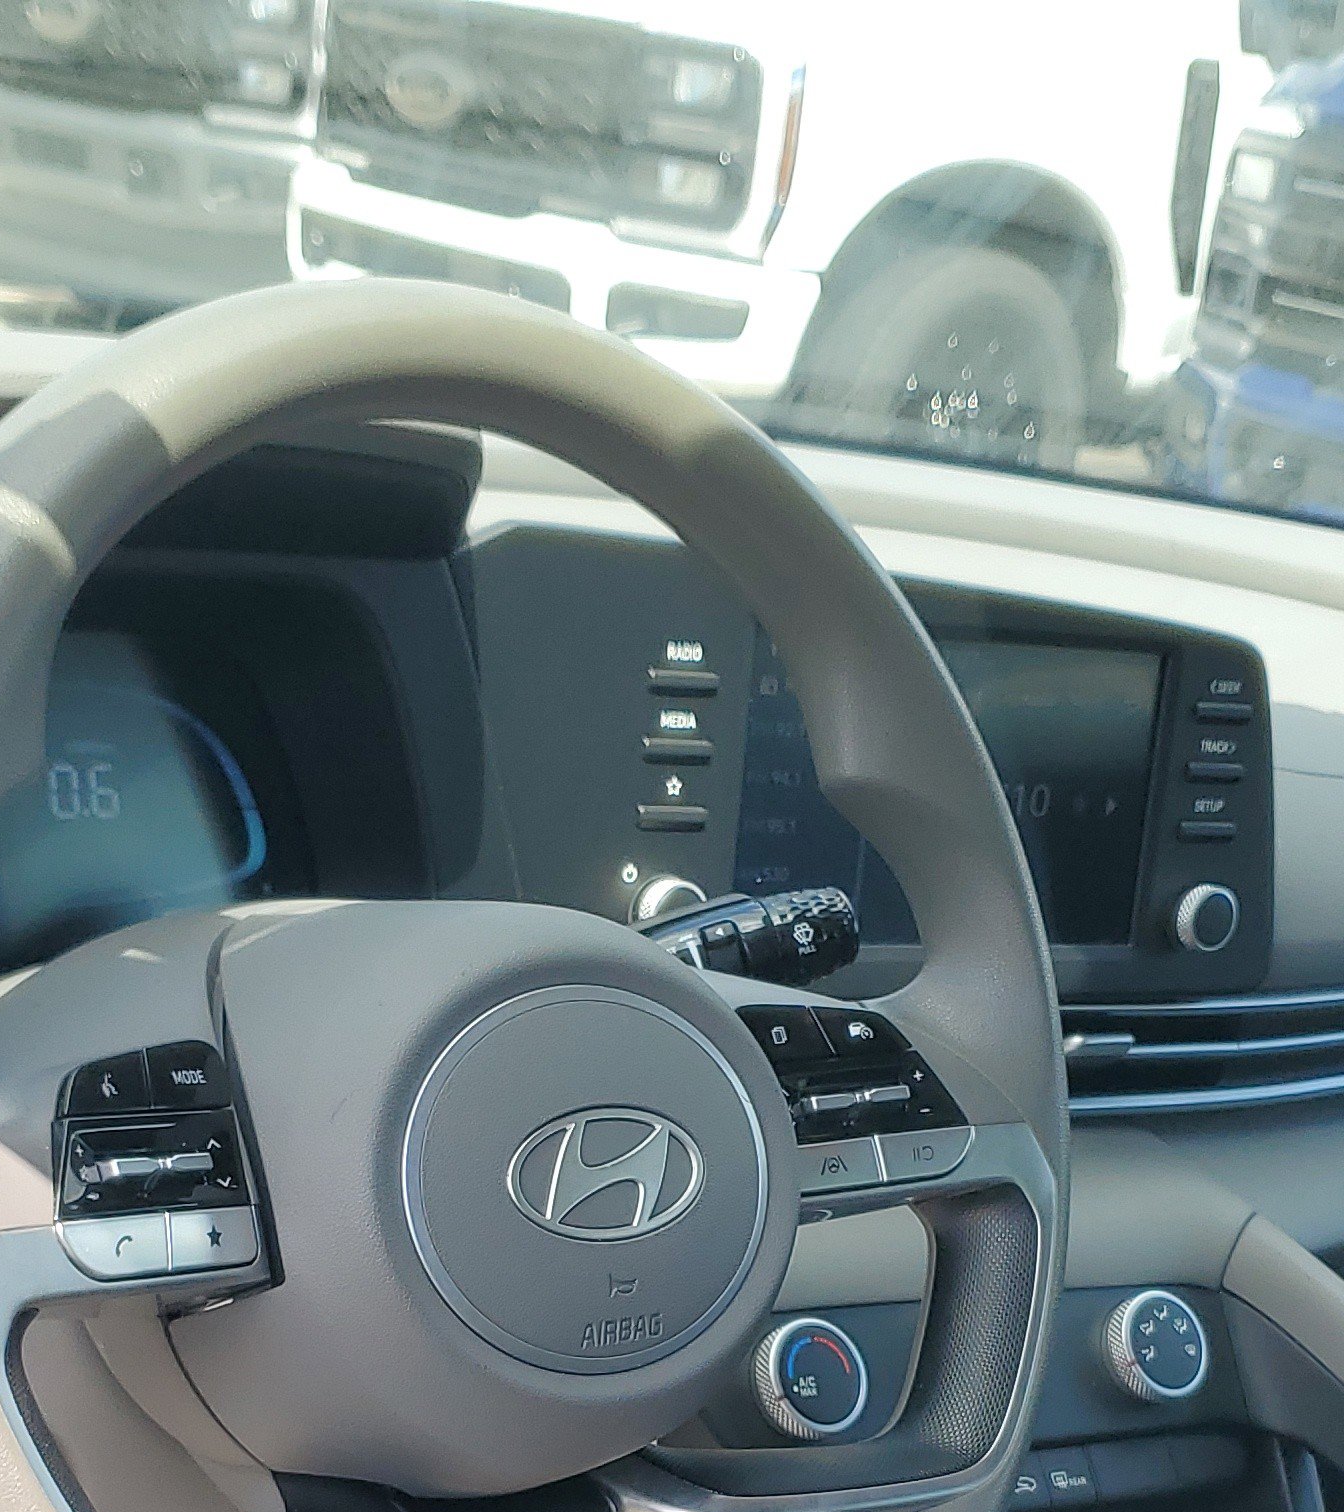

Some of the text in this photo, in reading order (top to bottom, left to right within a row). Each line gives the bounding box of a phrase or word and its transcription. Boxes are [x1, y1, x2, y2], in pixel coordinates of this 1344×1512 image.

[666, 638, 704, 662] RADIO
[659, 708, 697, 730] MEDIA
[171, 1068, 207, 1086] MODE
[581, 1311, 664, 1350] AIRBAG
[798, 1375, 817, 1388] A/C
